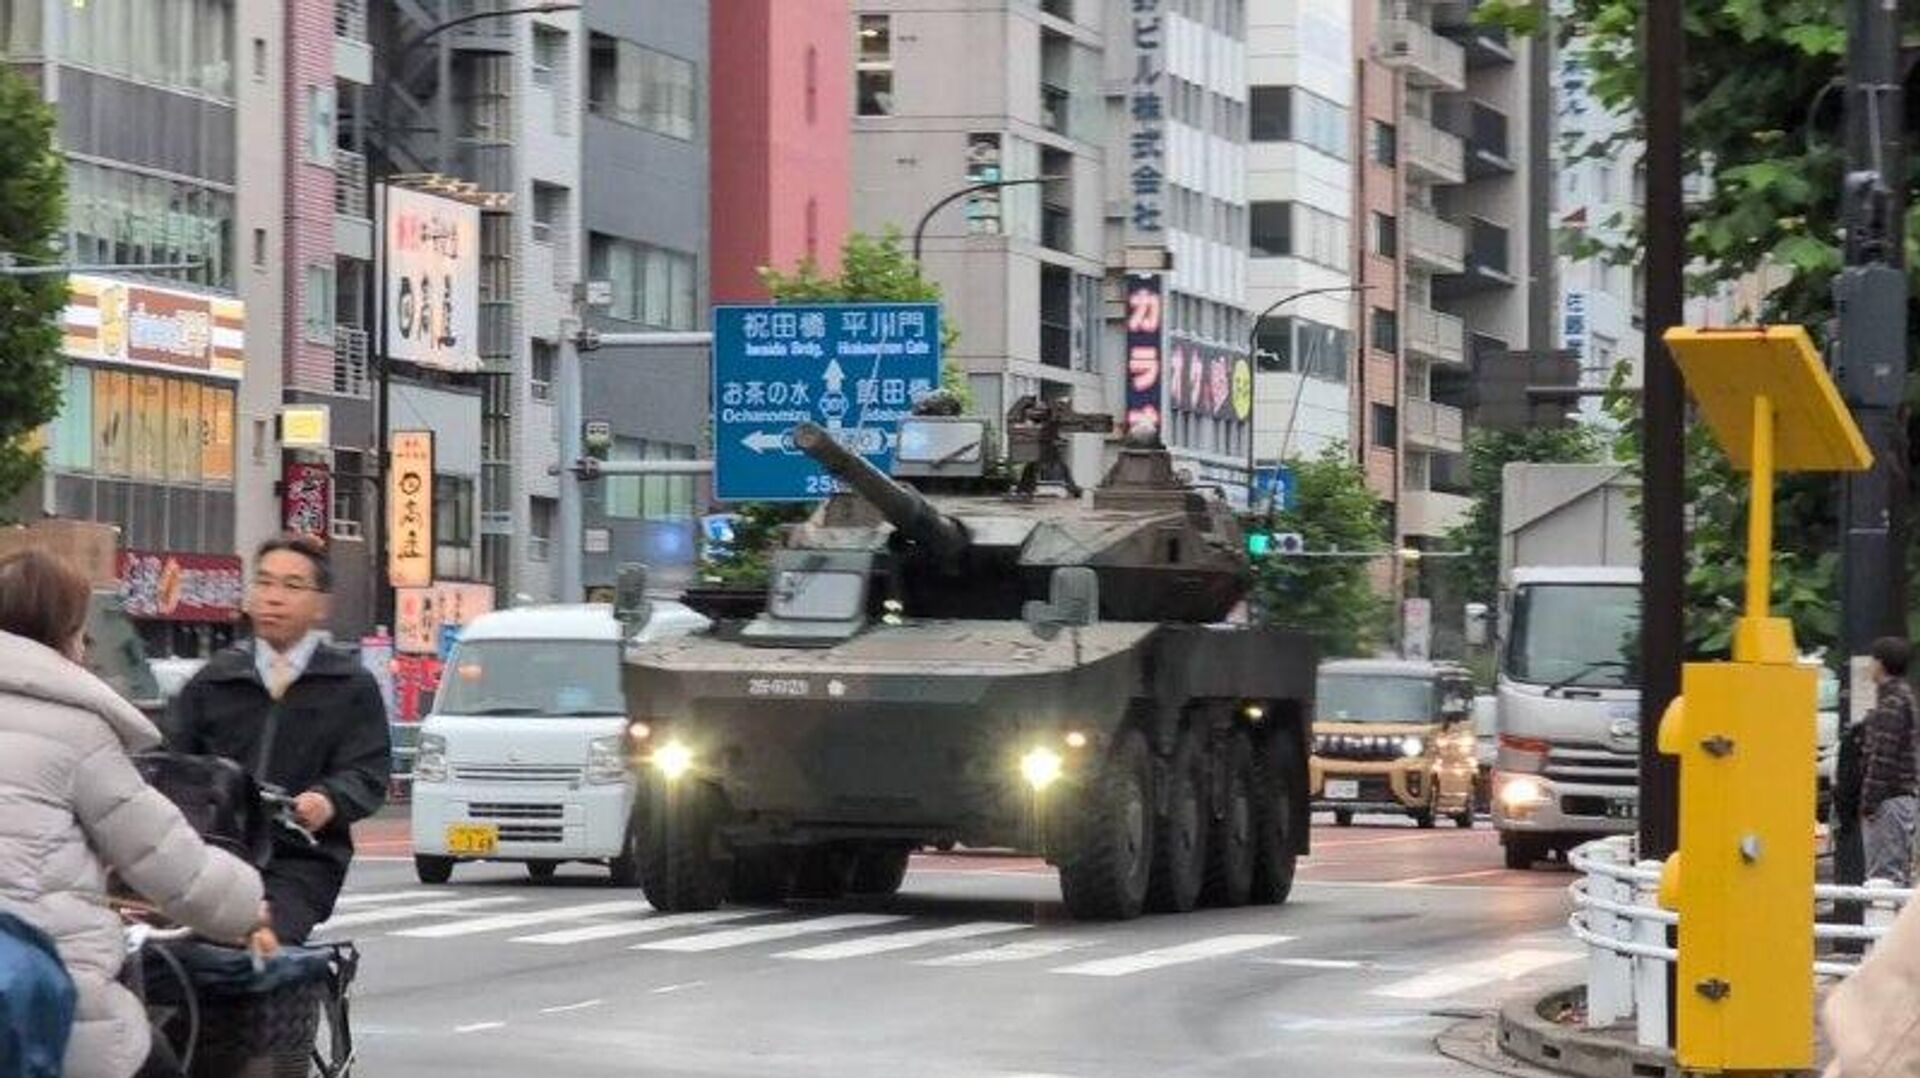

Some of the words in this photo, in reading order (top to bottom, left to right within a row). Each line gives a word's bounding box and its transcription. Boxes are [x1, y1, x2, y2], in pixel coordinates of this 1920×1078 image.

[841, 312, 925, 338] 平川門
[722, 382, 811, 406] お茶の水
